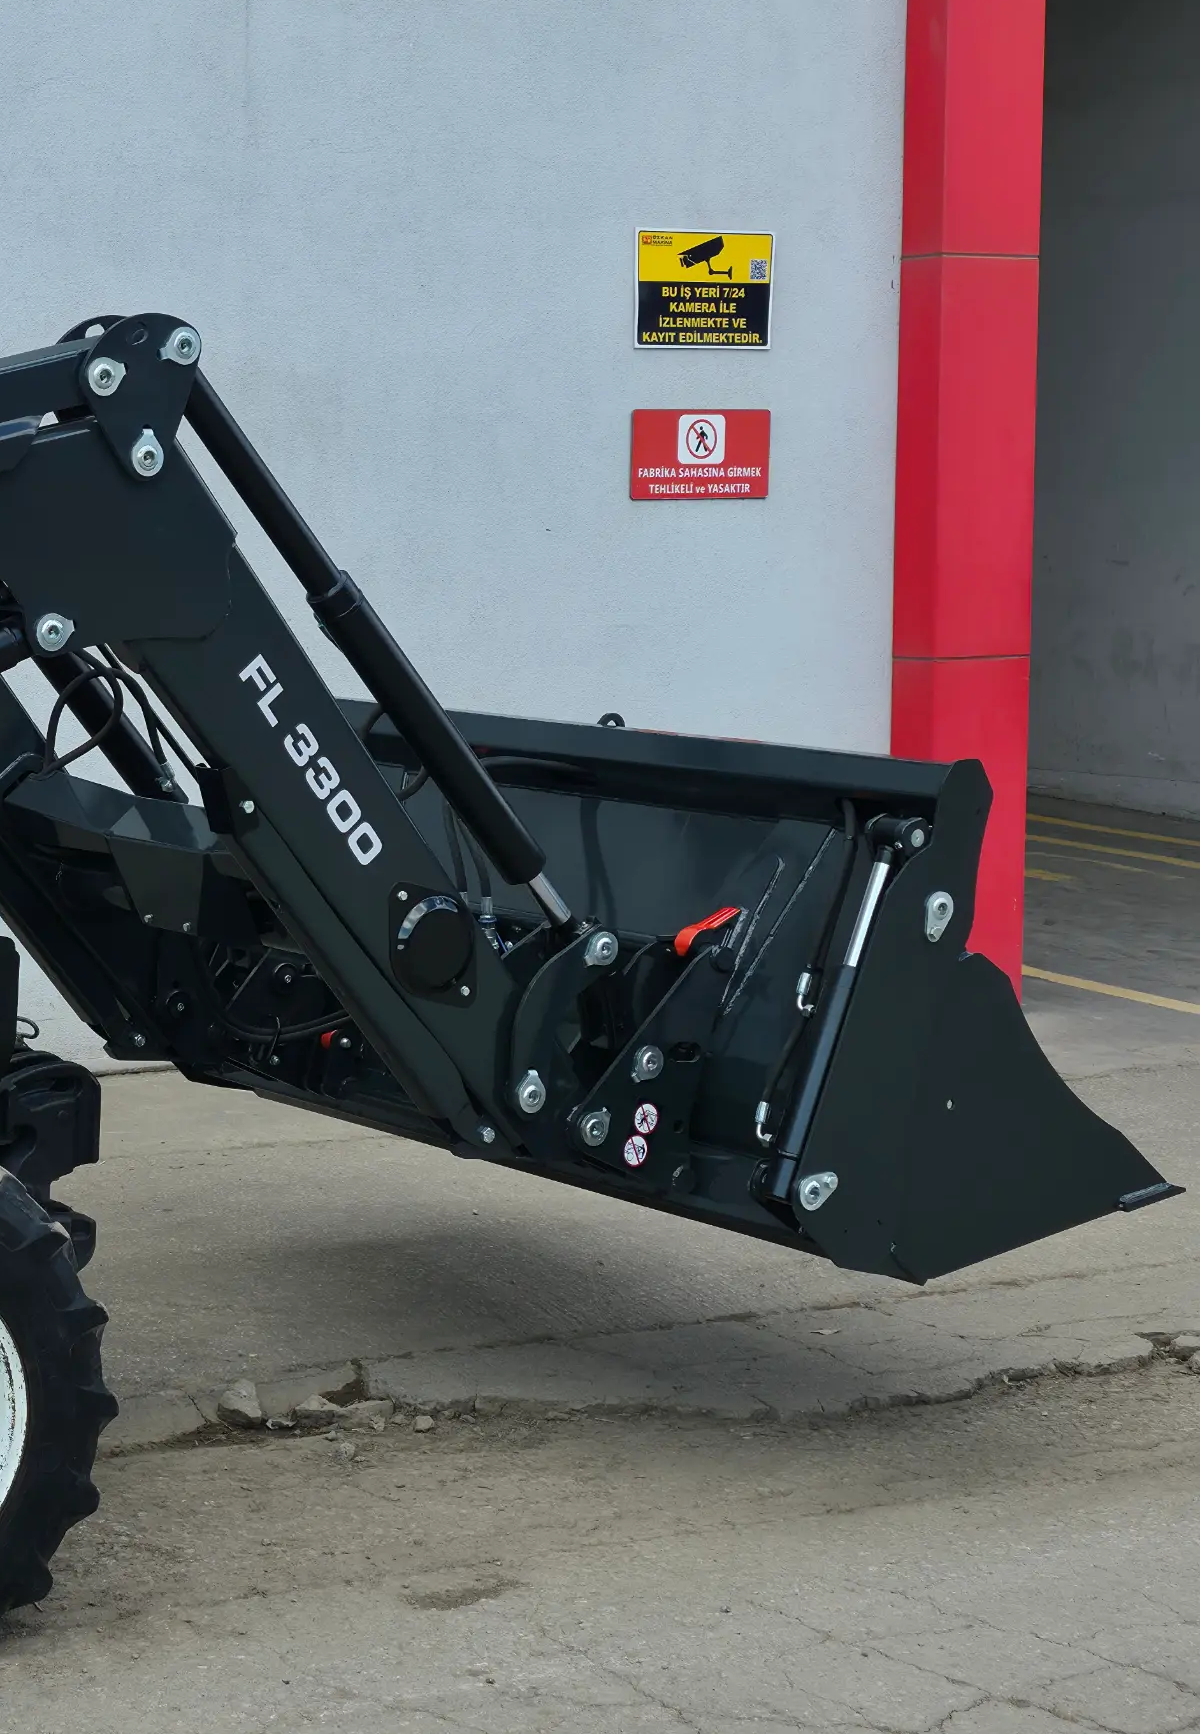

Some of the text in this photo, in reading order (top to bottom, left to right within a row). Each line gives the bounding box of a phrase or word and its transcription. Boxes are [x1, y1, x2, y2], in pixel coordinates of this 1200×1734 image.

[662, 285, 746, 300] BU İŞ YERİ 7/24
[669, 300, 737, 313] KAMERA İLE
[659, 315, 747, 328] İZLENMEKTE VE
[642, 330, 763, 344] KAYIT EDİLMEKTEDİR.
[638, 465, 761, 478] FABRİKA SAHASINA GİRMEK
[649, 482, 750, 494] TEHLİKELİ ve YASAKTIR
[238, 653, 383, 866] FL 3300
